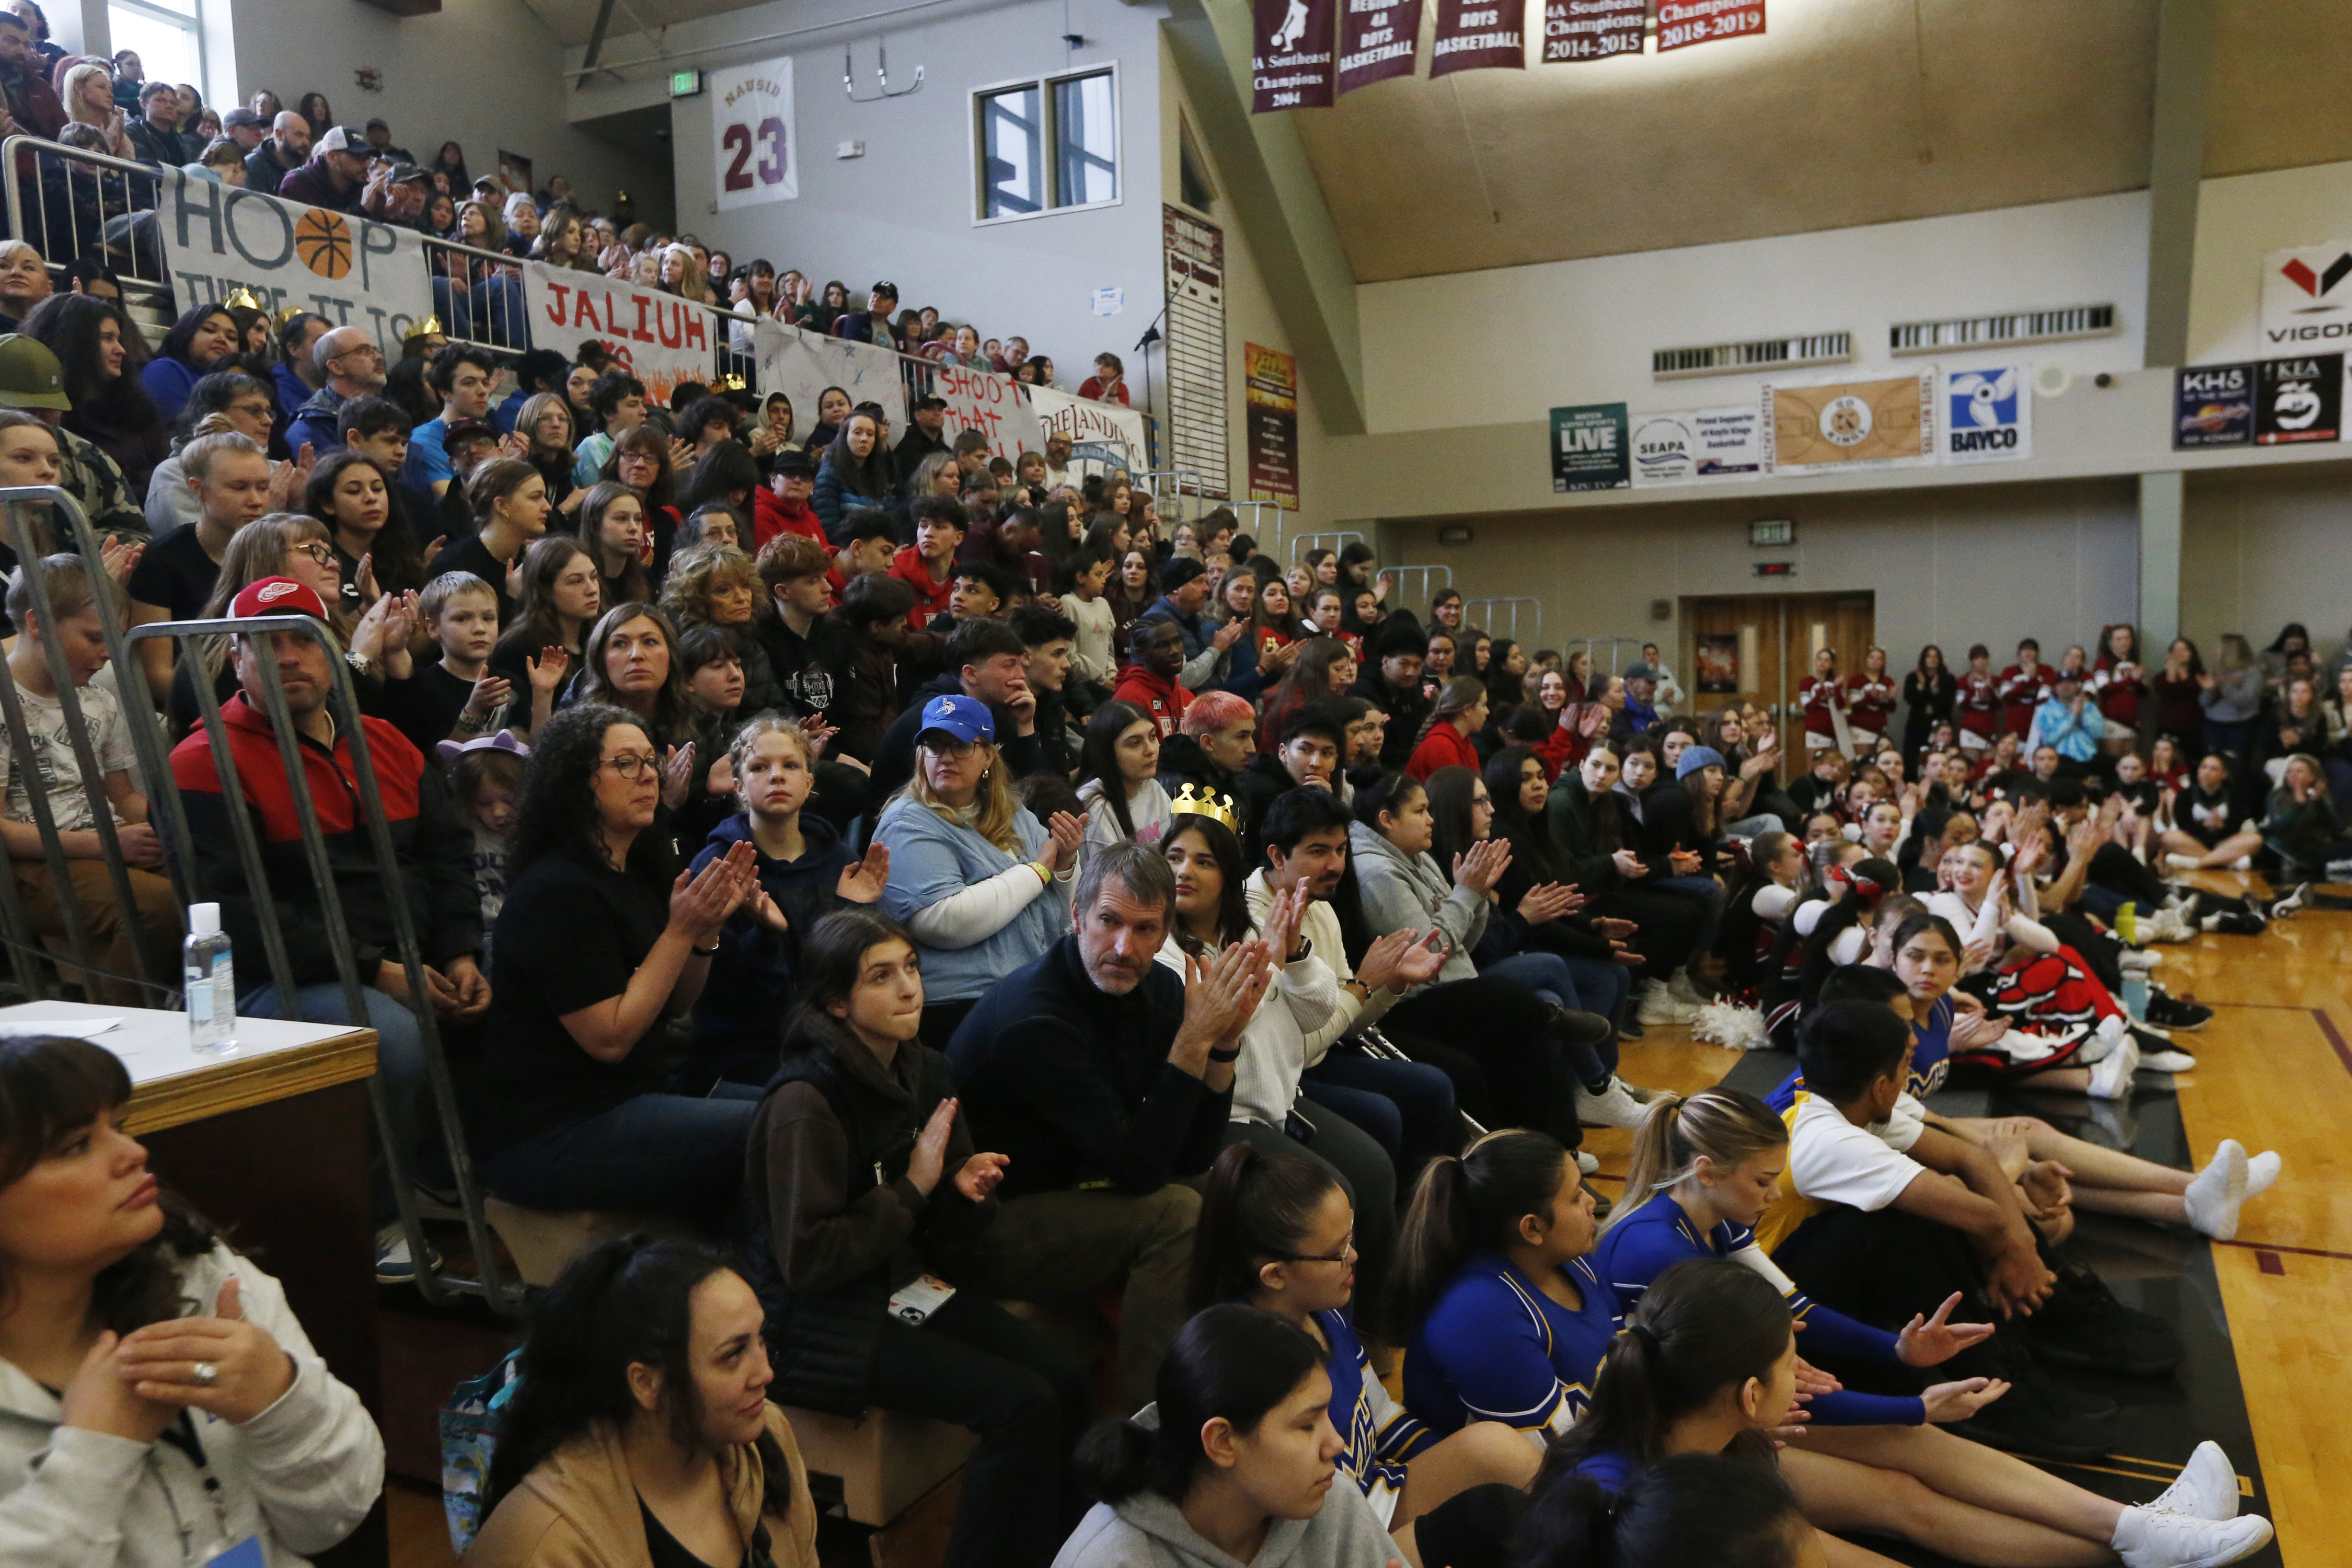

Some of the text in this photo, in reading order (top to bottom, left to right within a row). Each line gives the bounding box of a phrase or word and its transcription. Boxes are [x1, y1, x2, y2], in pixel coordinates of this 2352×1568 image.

[1460, 9, 1498, 28] BOYS
[1546, 13, 1644, 36] Champions
[1661, 10, 1761, 48] 2018-2019
[1360, 27, 1394, 49] BOYS
[1547, 32, 1640, 59] 2014-2015
[1268, 52, 1331, 68] Southeast
[1254, 72, 1323, 90] Champions
[723, 116, 788, 193] 23
[2267, 322, 2352, 343] VIGO
[2182, 368, 2245, 391] KHS
[1561, 426, 1617, 454] LIVE
[1640, 441, 1686, 454] SEAPA
[1951, 428, 2017, 453] BAYCO
[1152, 699, 1162, 710] GH
